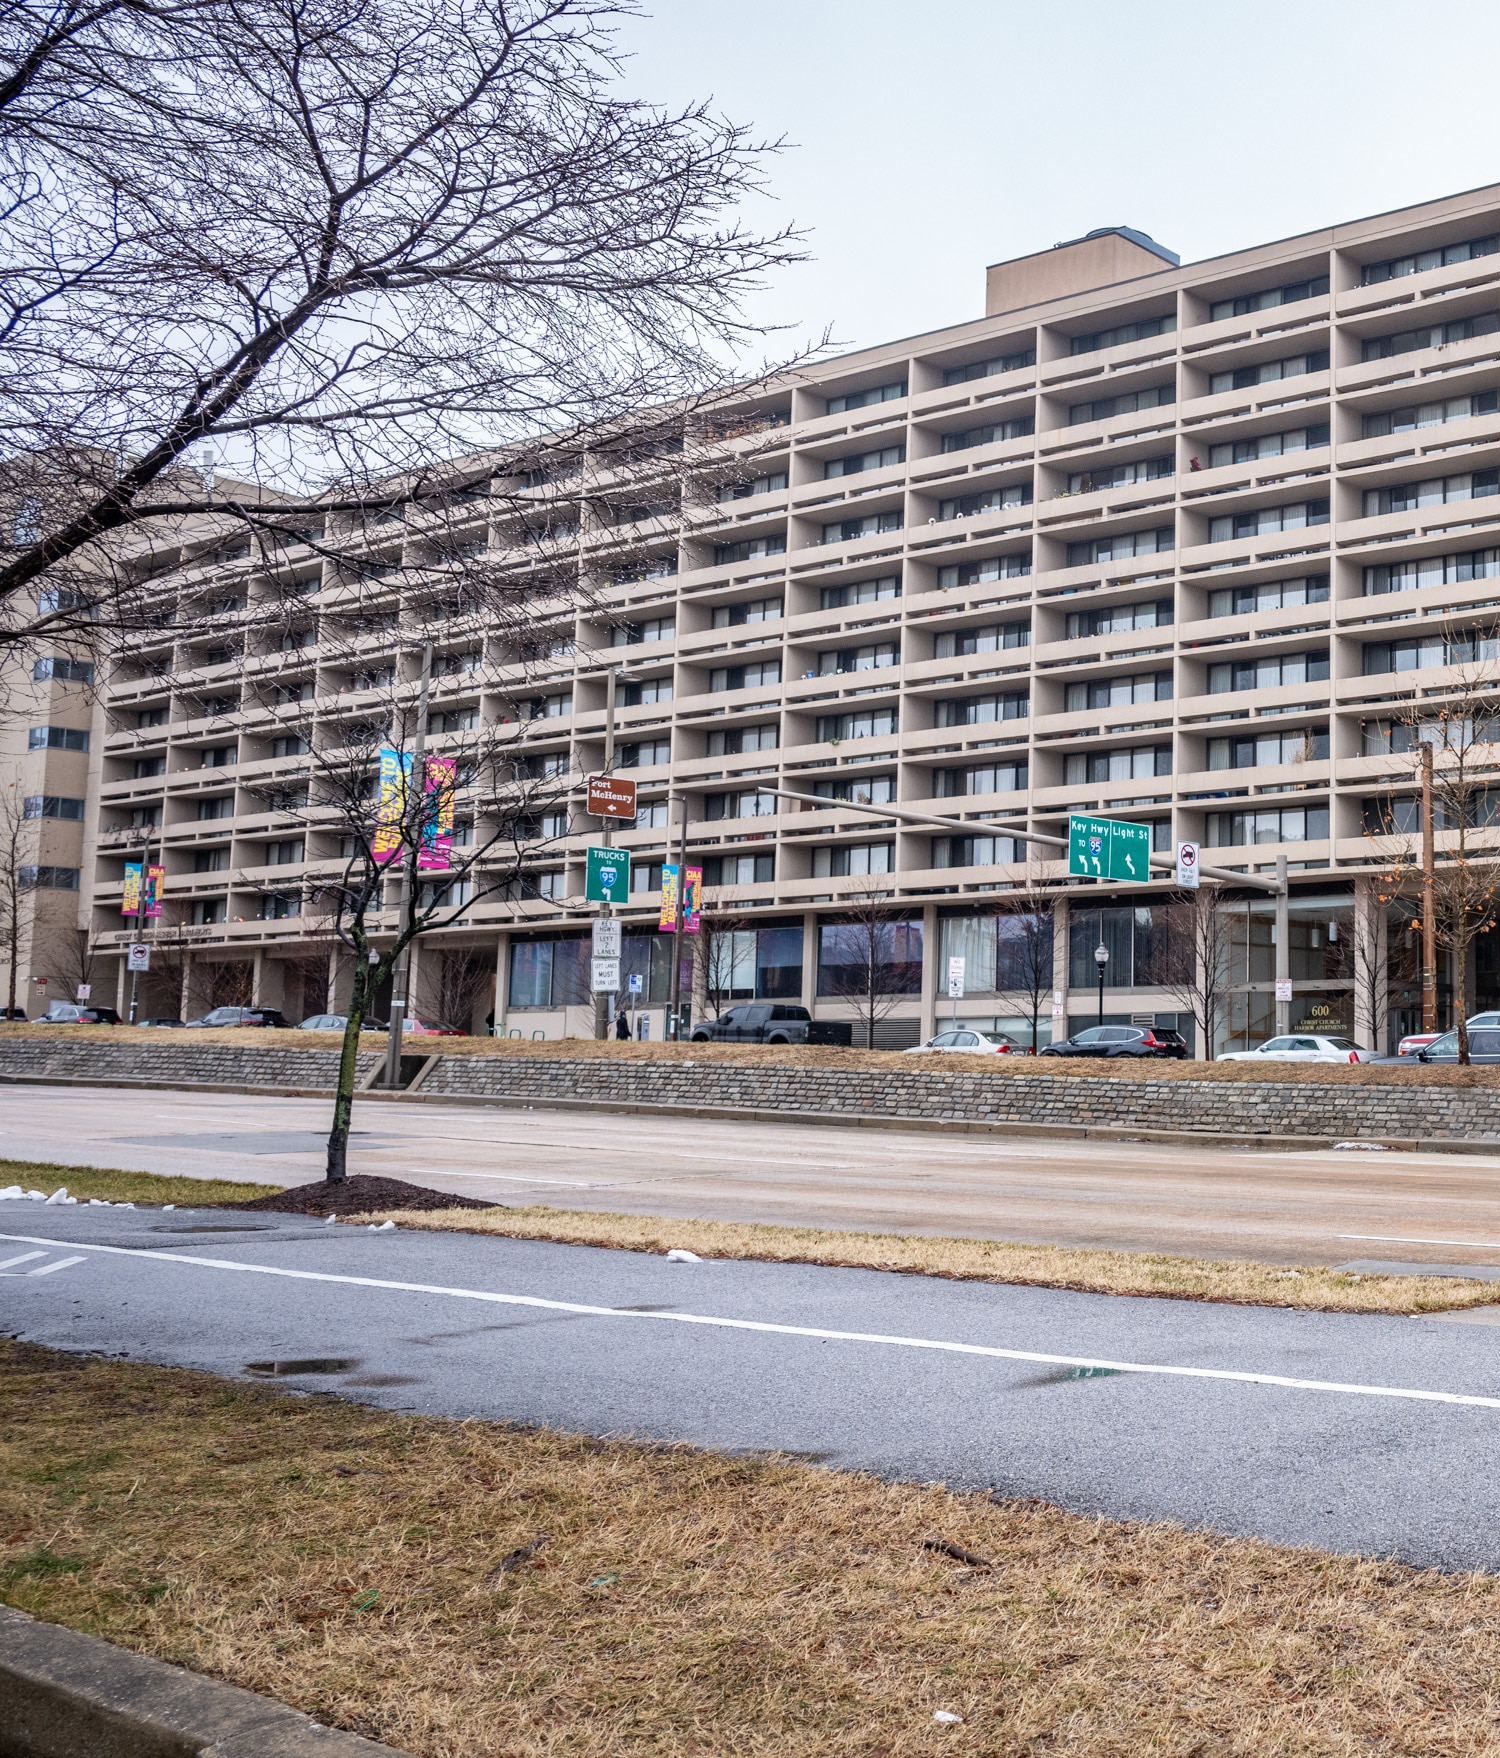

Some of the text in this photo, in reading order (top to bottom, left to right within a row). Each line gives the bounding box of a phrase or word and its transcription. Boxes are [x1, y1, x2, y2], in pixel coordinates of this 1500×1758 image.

[381, 757, 396, 776] TO
[591, 779, 611, 789] Fort
[591, 790, 633, 804] McHenry
[1072, 820, 1109, 836] Key Hwy
[1113, 826, 1148, 840] Light St
[1078, 839, 1086, 847] TO
[1090, 841, 1101, 852] 95
[593, 850, 625, 861] TRUCKS
[602, 872, 614, 883] 95
[686, 870, 702, 879] CIAA
[660, 869, 670, 926] WELCOME TO
[668, 874, 677, 923] BALTIMORE
[1312, 1005, 1329, 1016] 600
